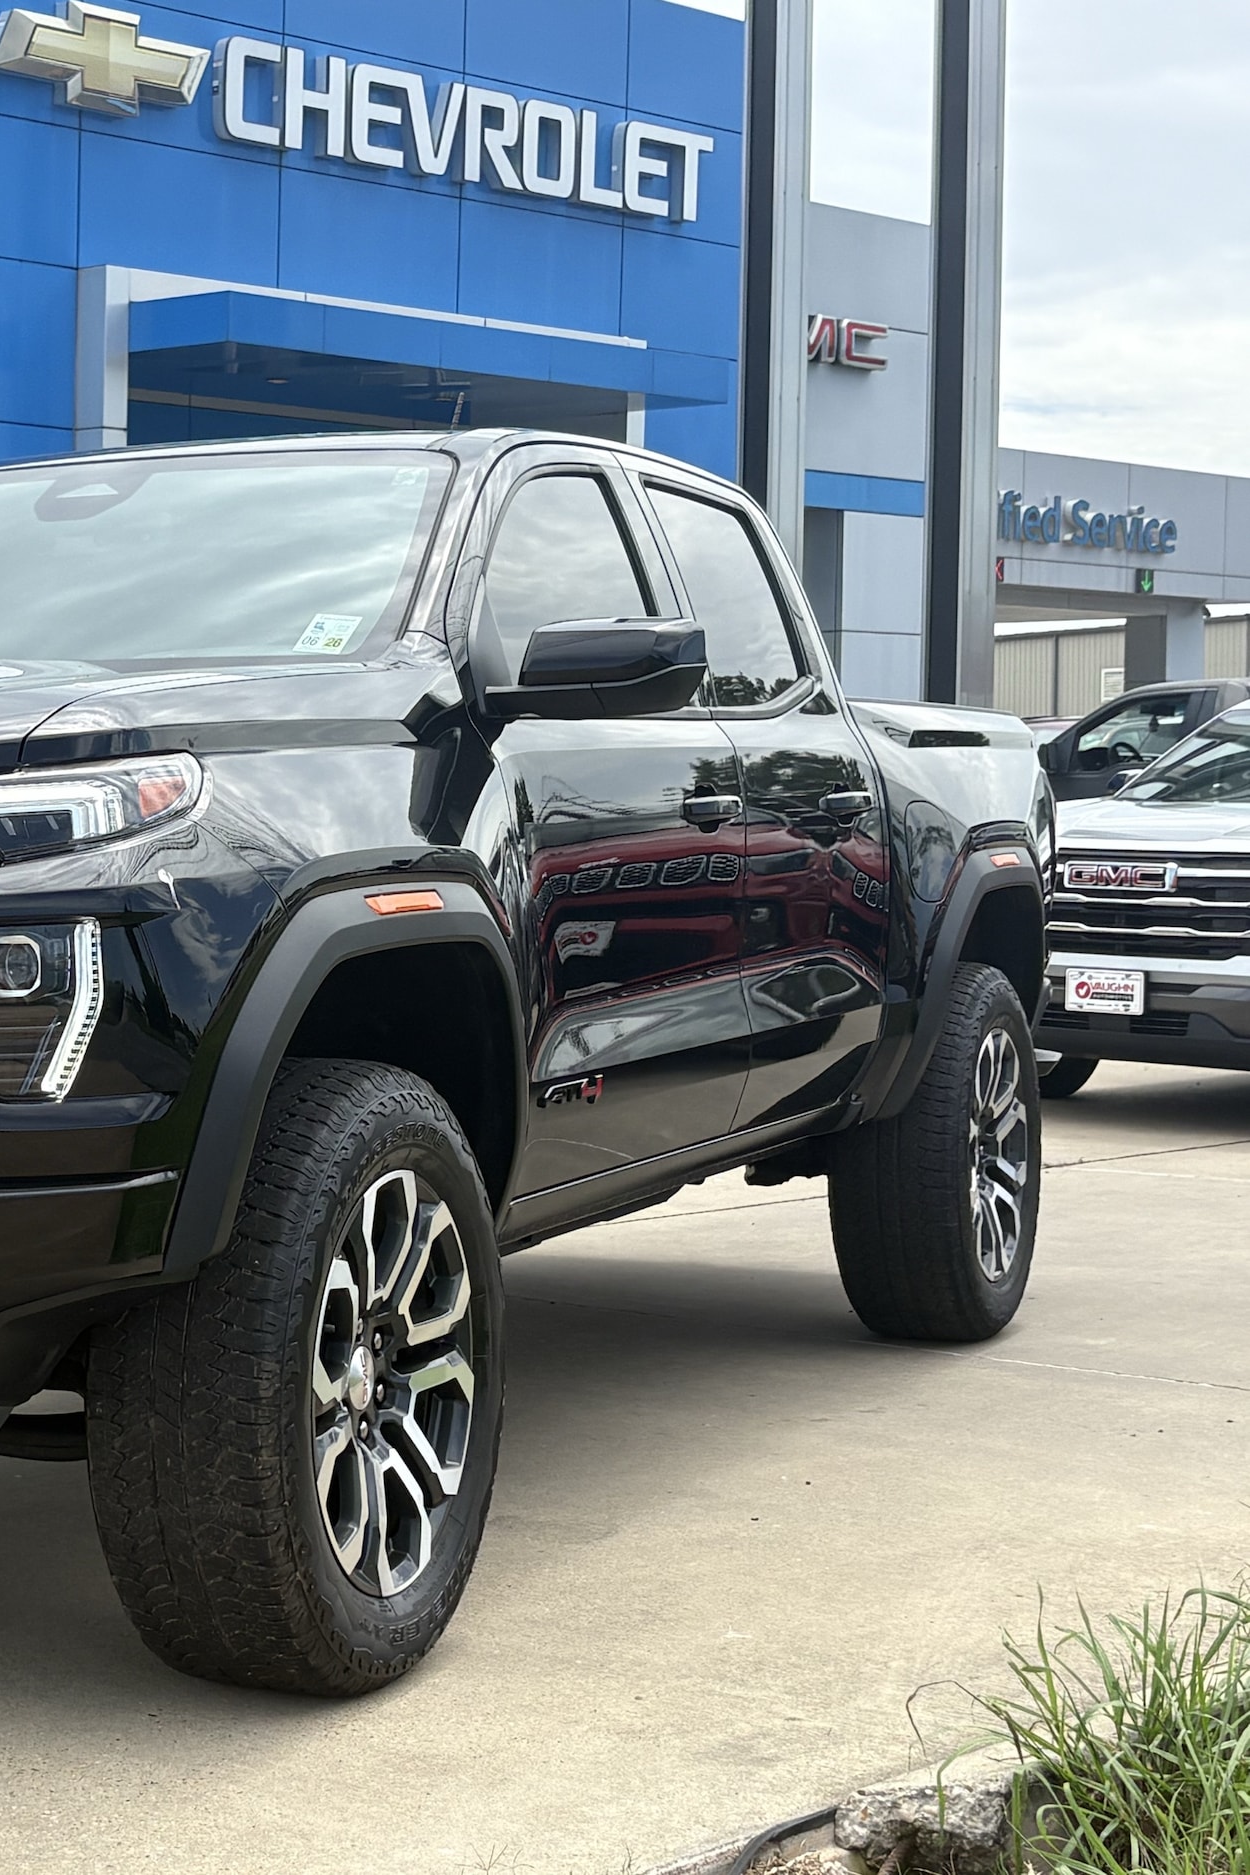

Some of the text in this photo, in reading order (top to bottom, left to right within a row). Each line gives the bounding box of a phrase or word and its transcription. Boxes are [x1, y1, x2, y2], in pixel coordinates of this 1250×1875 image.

[214, 35, 714, 223] CHEVROLET
[1065, 499, 1177, 554] Service
[301, 635, 320, 646] 06
[1068, 865, 1166, 888] GMC
[1090, 982, 1135, 992] VAUGHN
